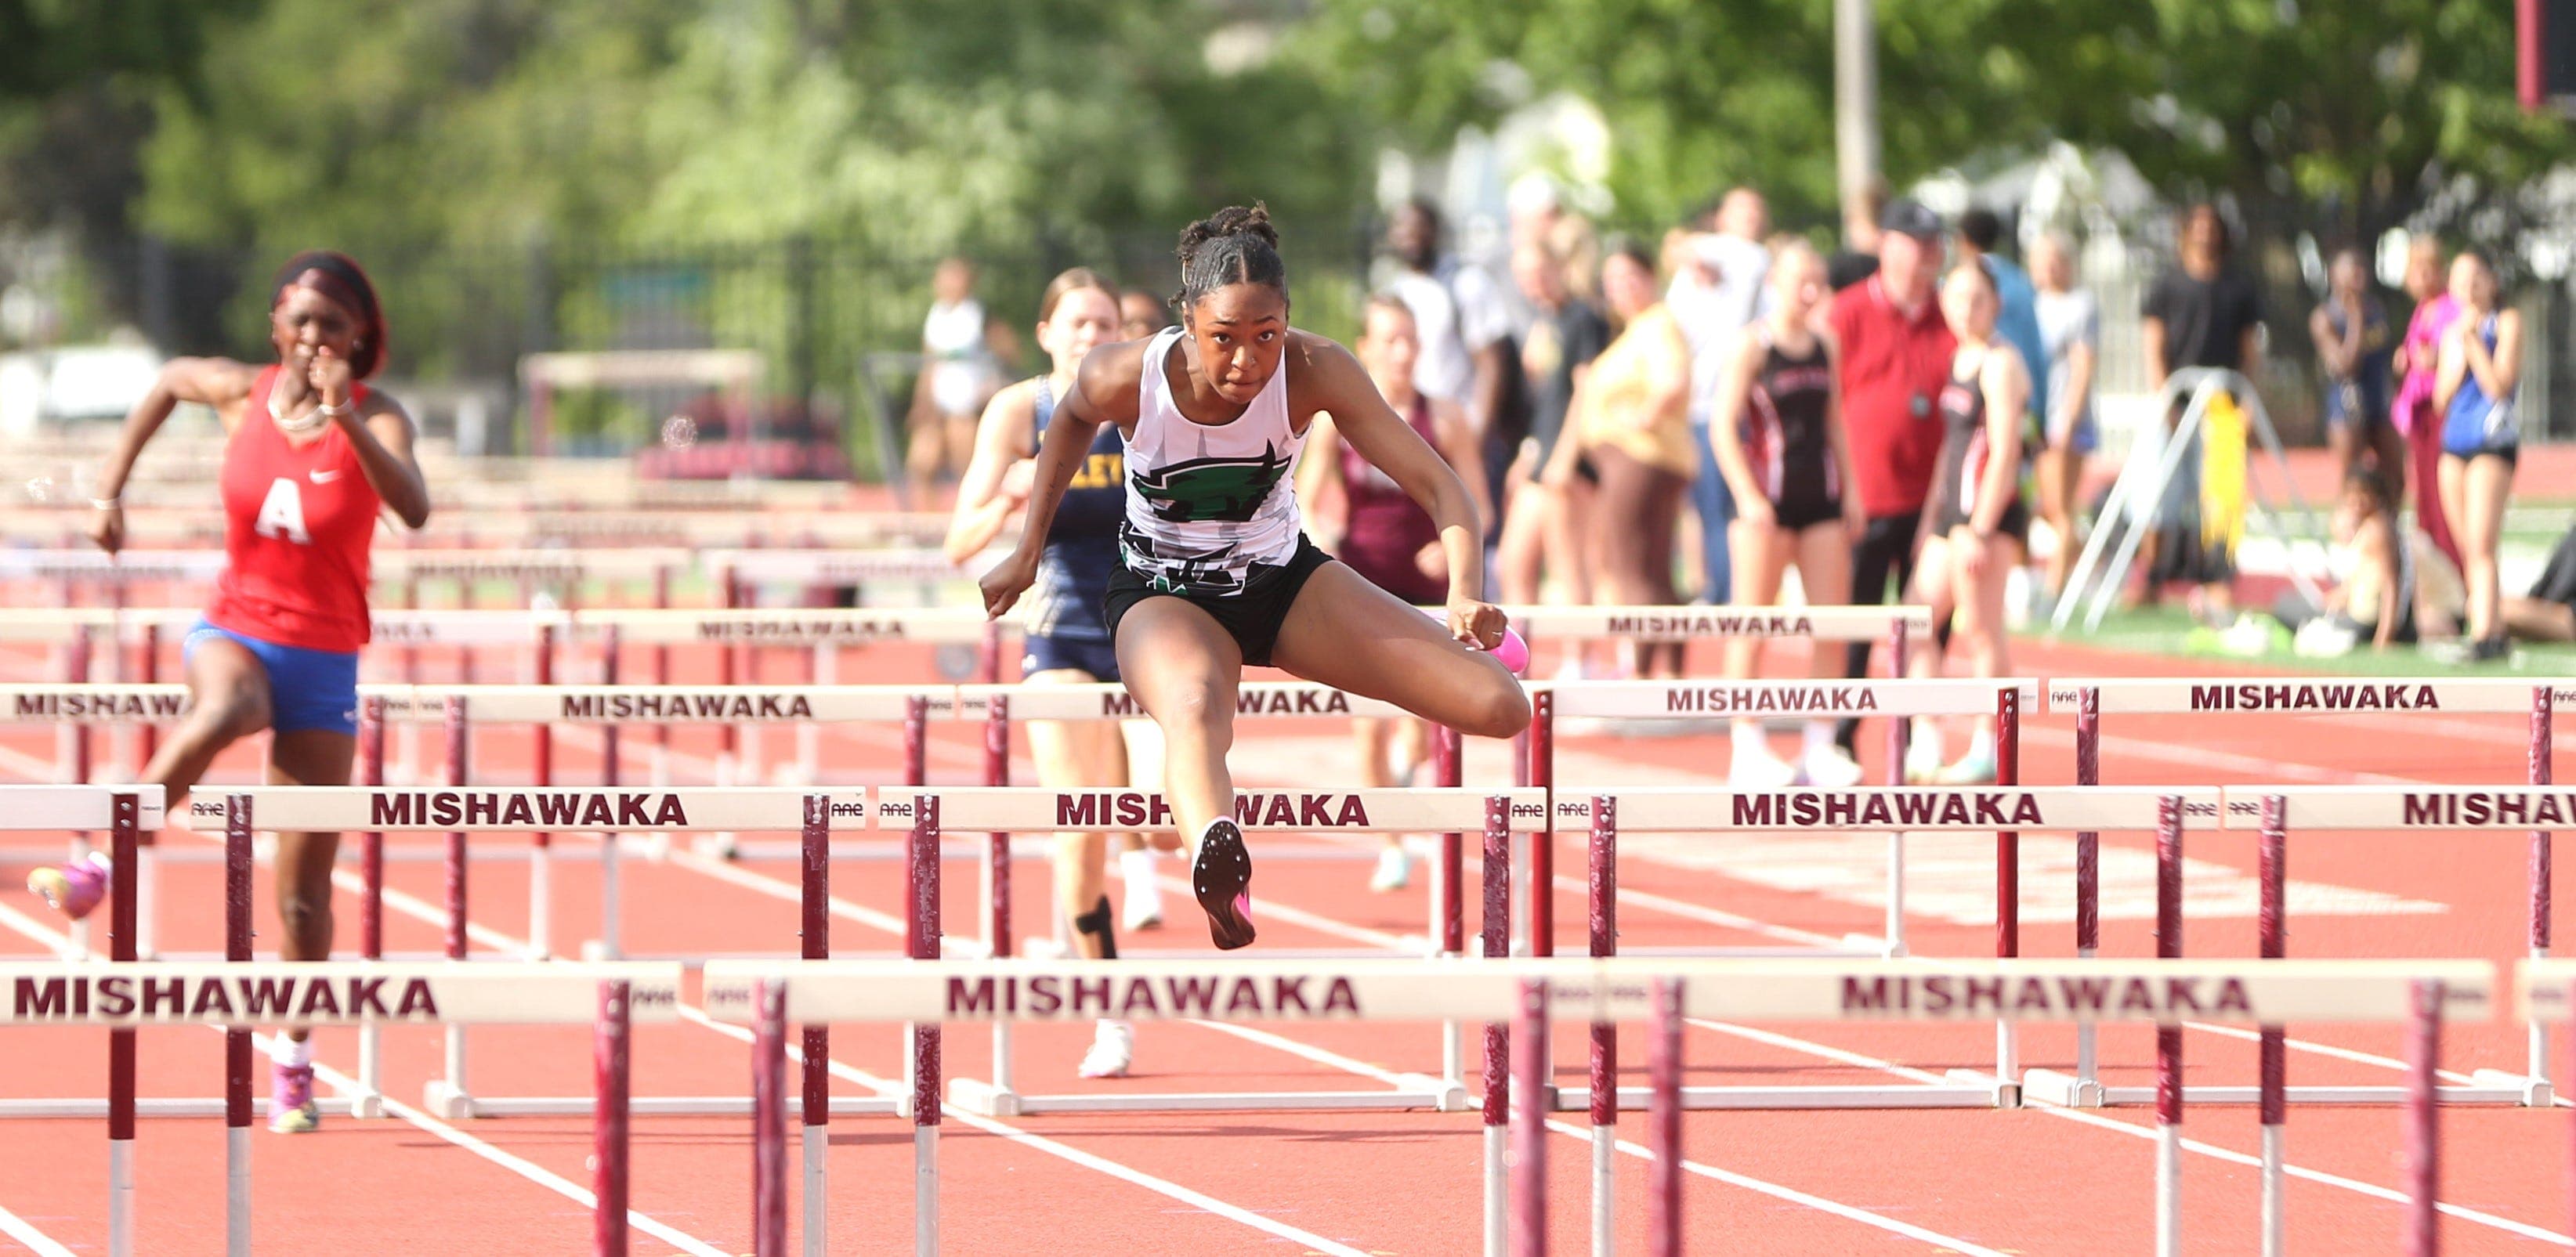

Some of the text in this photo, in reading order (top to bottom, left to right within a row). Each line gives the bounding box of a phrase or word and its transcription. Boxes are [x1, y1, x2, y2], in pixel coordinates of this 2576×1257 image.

[254, 477, 312, 545] A
[1608, 617, 1813, 634] MISHAWAKA
[14, 694, 193, 715] MISHAW
[563, 695, 812, 718] MISHAWAKA
[1666, 688, 1878, 712] MISHAWAKA
[2191, 685, 2440, 710] MISHAWAKA
[371, 793, 688, 825] MISHAWAKA
[1057, 793, 1369, 826] MISHWAKA
[1732, 793, 2044, 826] MISHAWAKA
[2404, 793, 2576, 825] MISHA
[14, 977, 439, 1017] MISHAWAKA
[947, 976, 1361, 1016] MISHAWAKA
[1840, 976, 2252, 1015] MISHAWAKA
